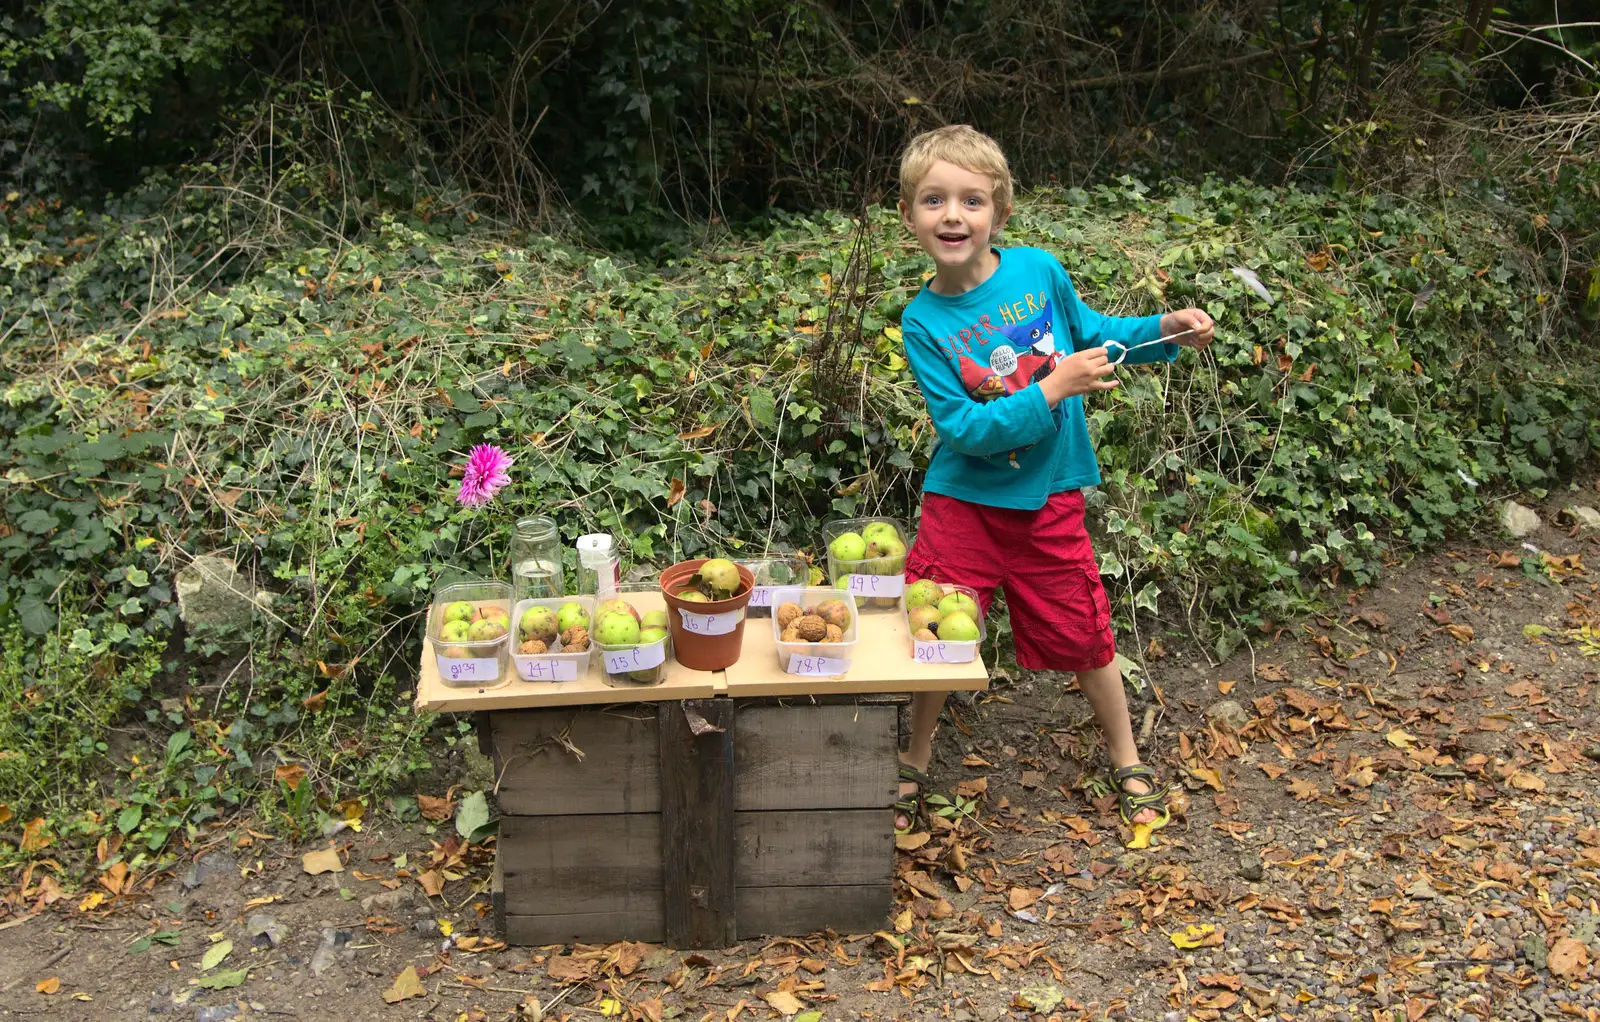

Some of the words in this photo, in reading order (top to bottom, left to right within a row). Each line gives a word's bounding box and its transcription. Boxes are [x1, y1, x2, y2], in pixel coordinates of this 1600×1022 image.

[936, 314, 1000, 361] SUPER
[997, 292, 1047, 327] HERO
[990, 352, 1015, 366] FEEBLE
[992, 347, 1011, 359] HELLO
[995, 359, 1017, 372] HUMAN
[684, 614, 699, 630] 16
[611, 656, 629, 670] 15
[795, 658, 813, 673] 18
